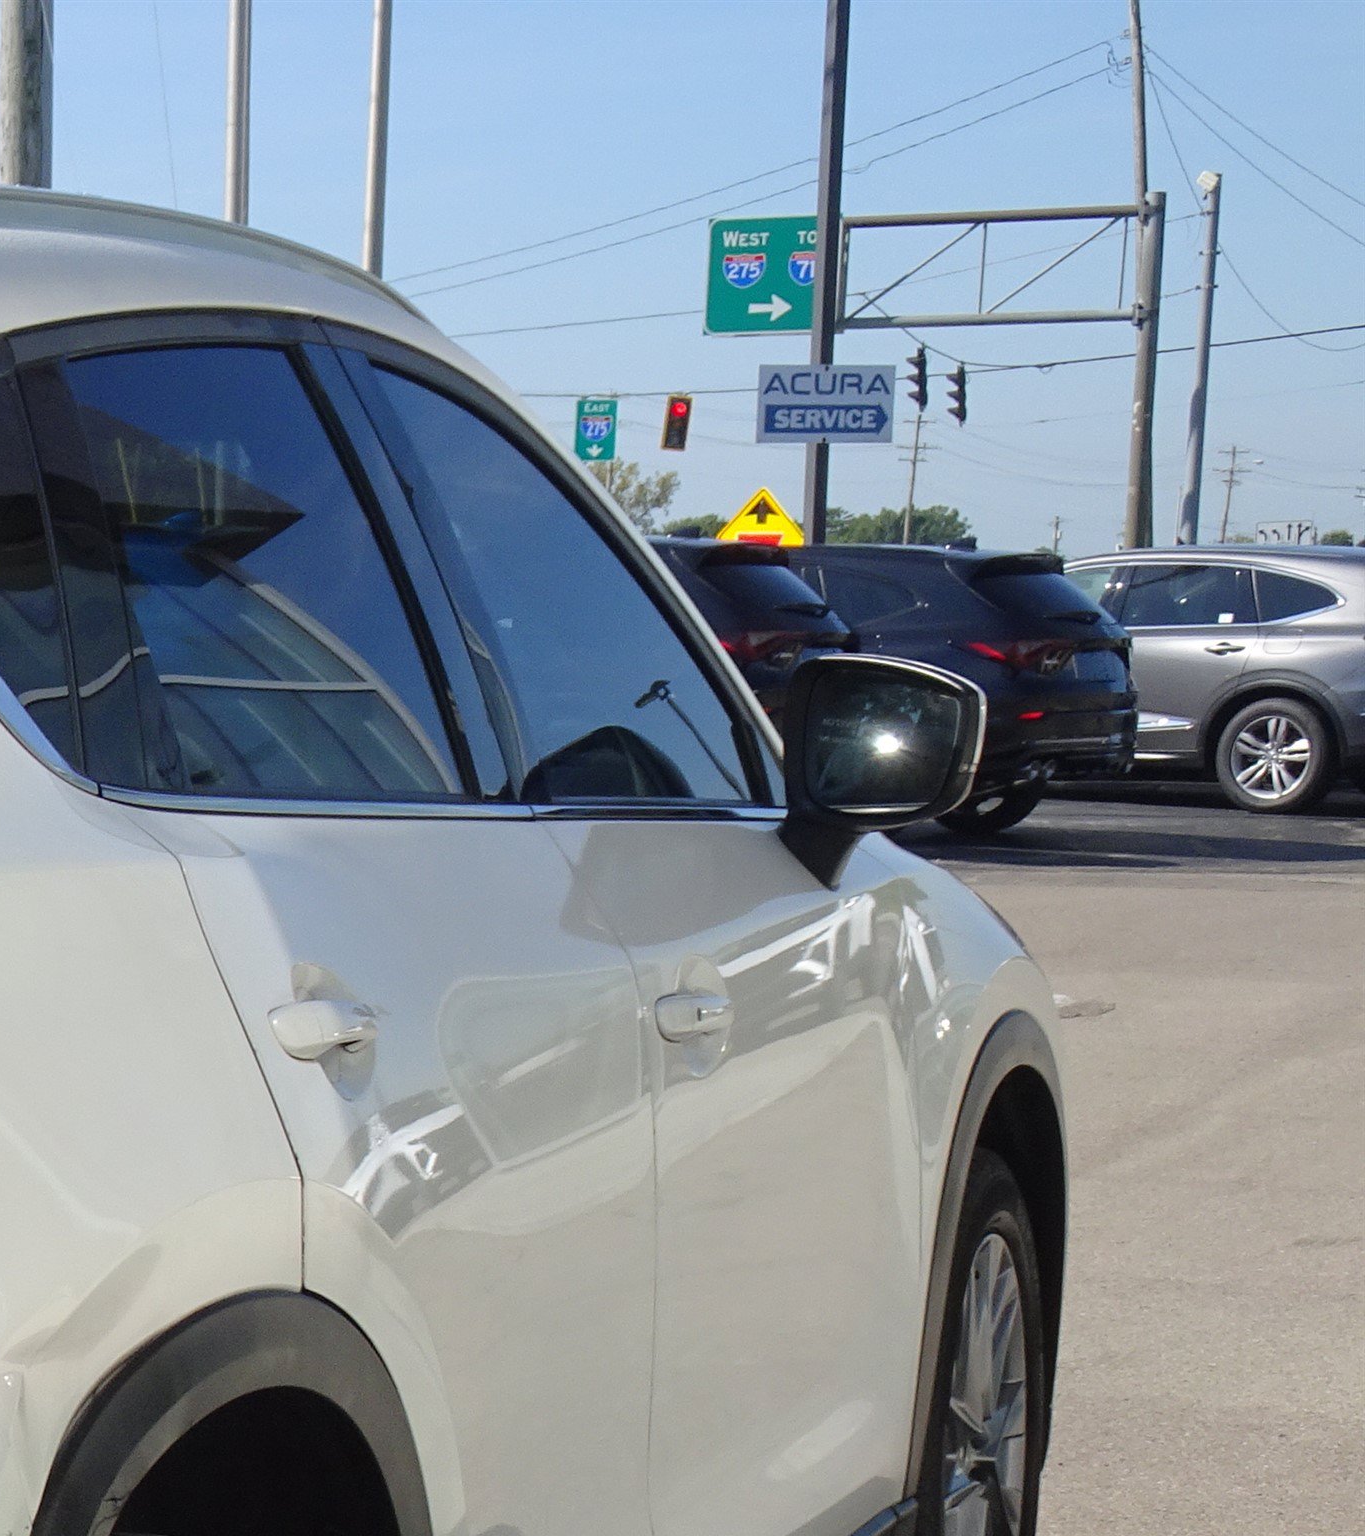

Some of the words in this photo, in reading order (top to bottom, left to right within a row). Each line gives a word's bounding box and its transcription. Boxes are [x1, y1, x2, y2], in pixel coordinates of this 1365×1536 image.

[722, 230, 769, 247] WEST
[728, 263, 760, 279] 275
[796, 261, 815, 279] 71
[763, 373, 891, 395] ACURA
[774, 409, 877, 429] SERVICE
[587, 421, 607, 436] 275
